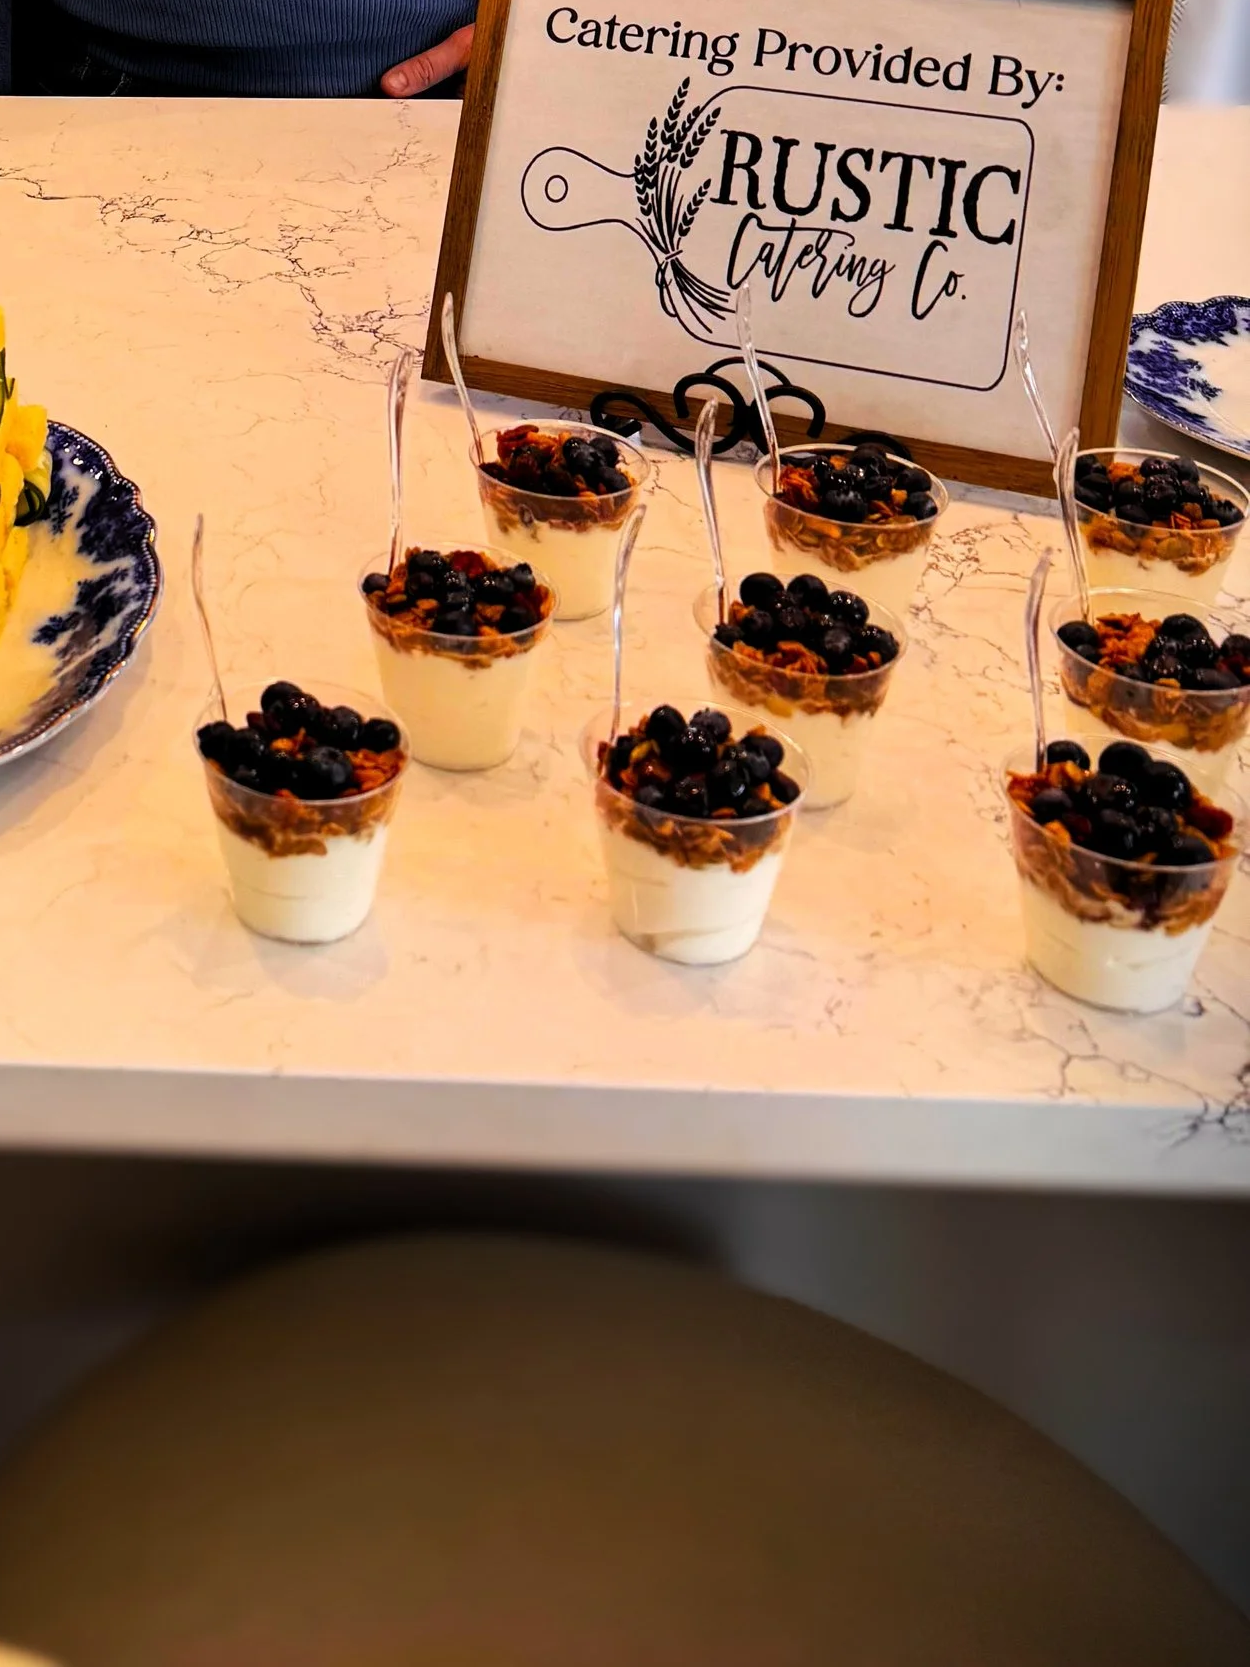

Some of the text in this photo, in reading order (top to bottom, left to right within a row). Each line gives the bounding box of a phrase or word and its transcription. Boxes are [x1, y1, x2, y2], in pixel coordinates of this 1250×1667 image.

[546, 6, 1066, 110] Catering Provided By:
[710, 129, 1022, 246] RUSTIC
[726, 212, 968, 321] Catering Co.
